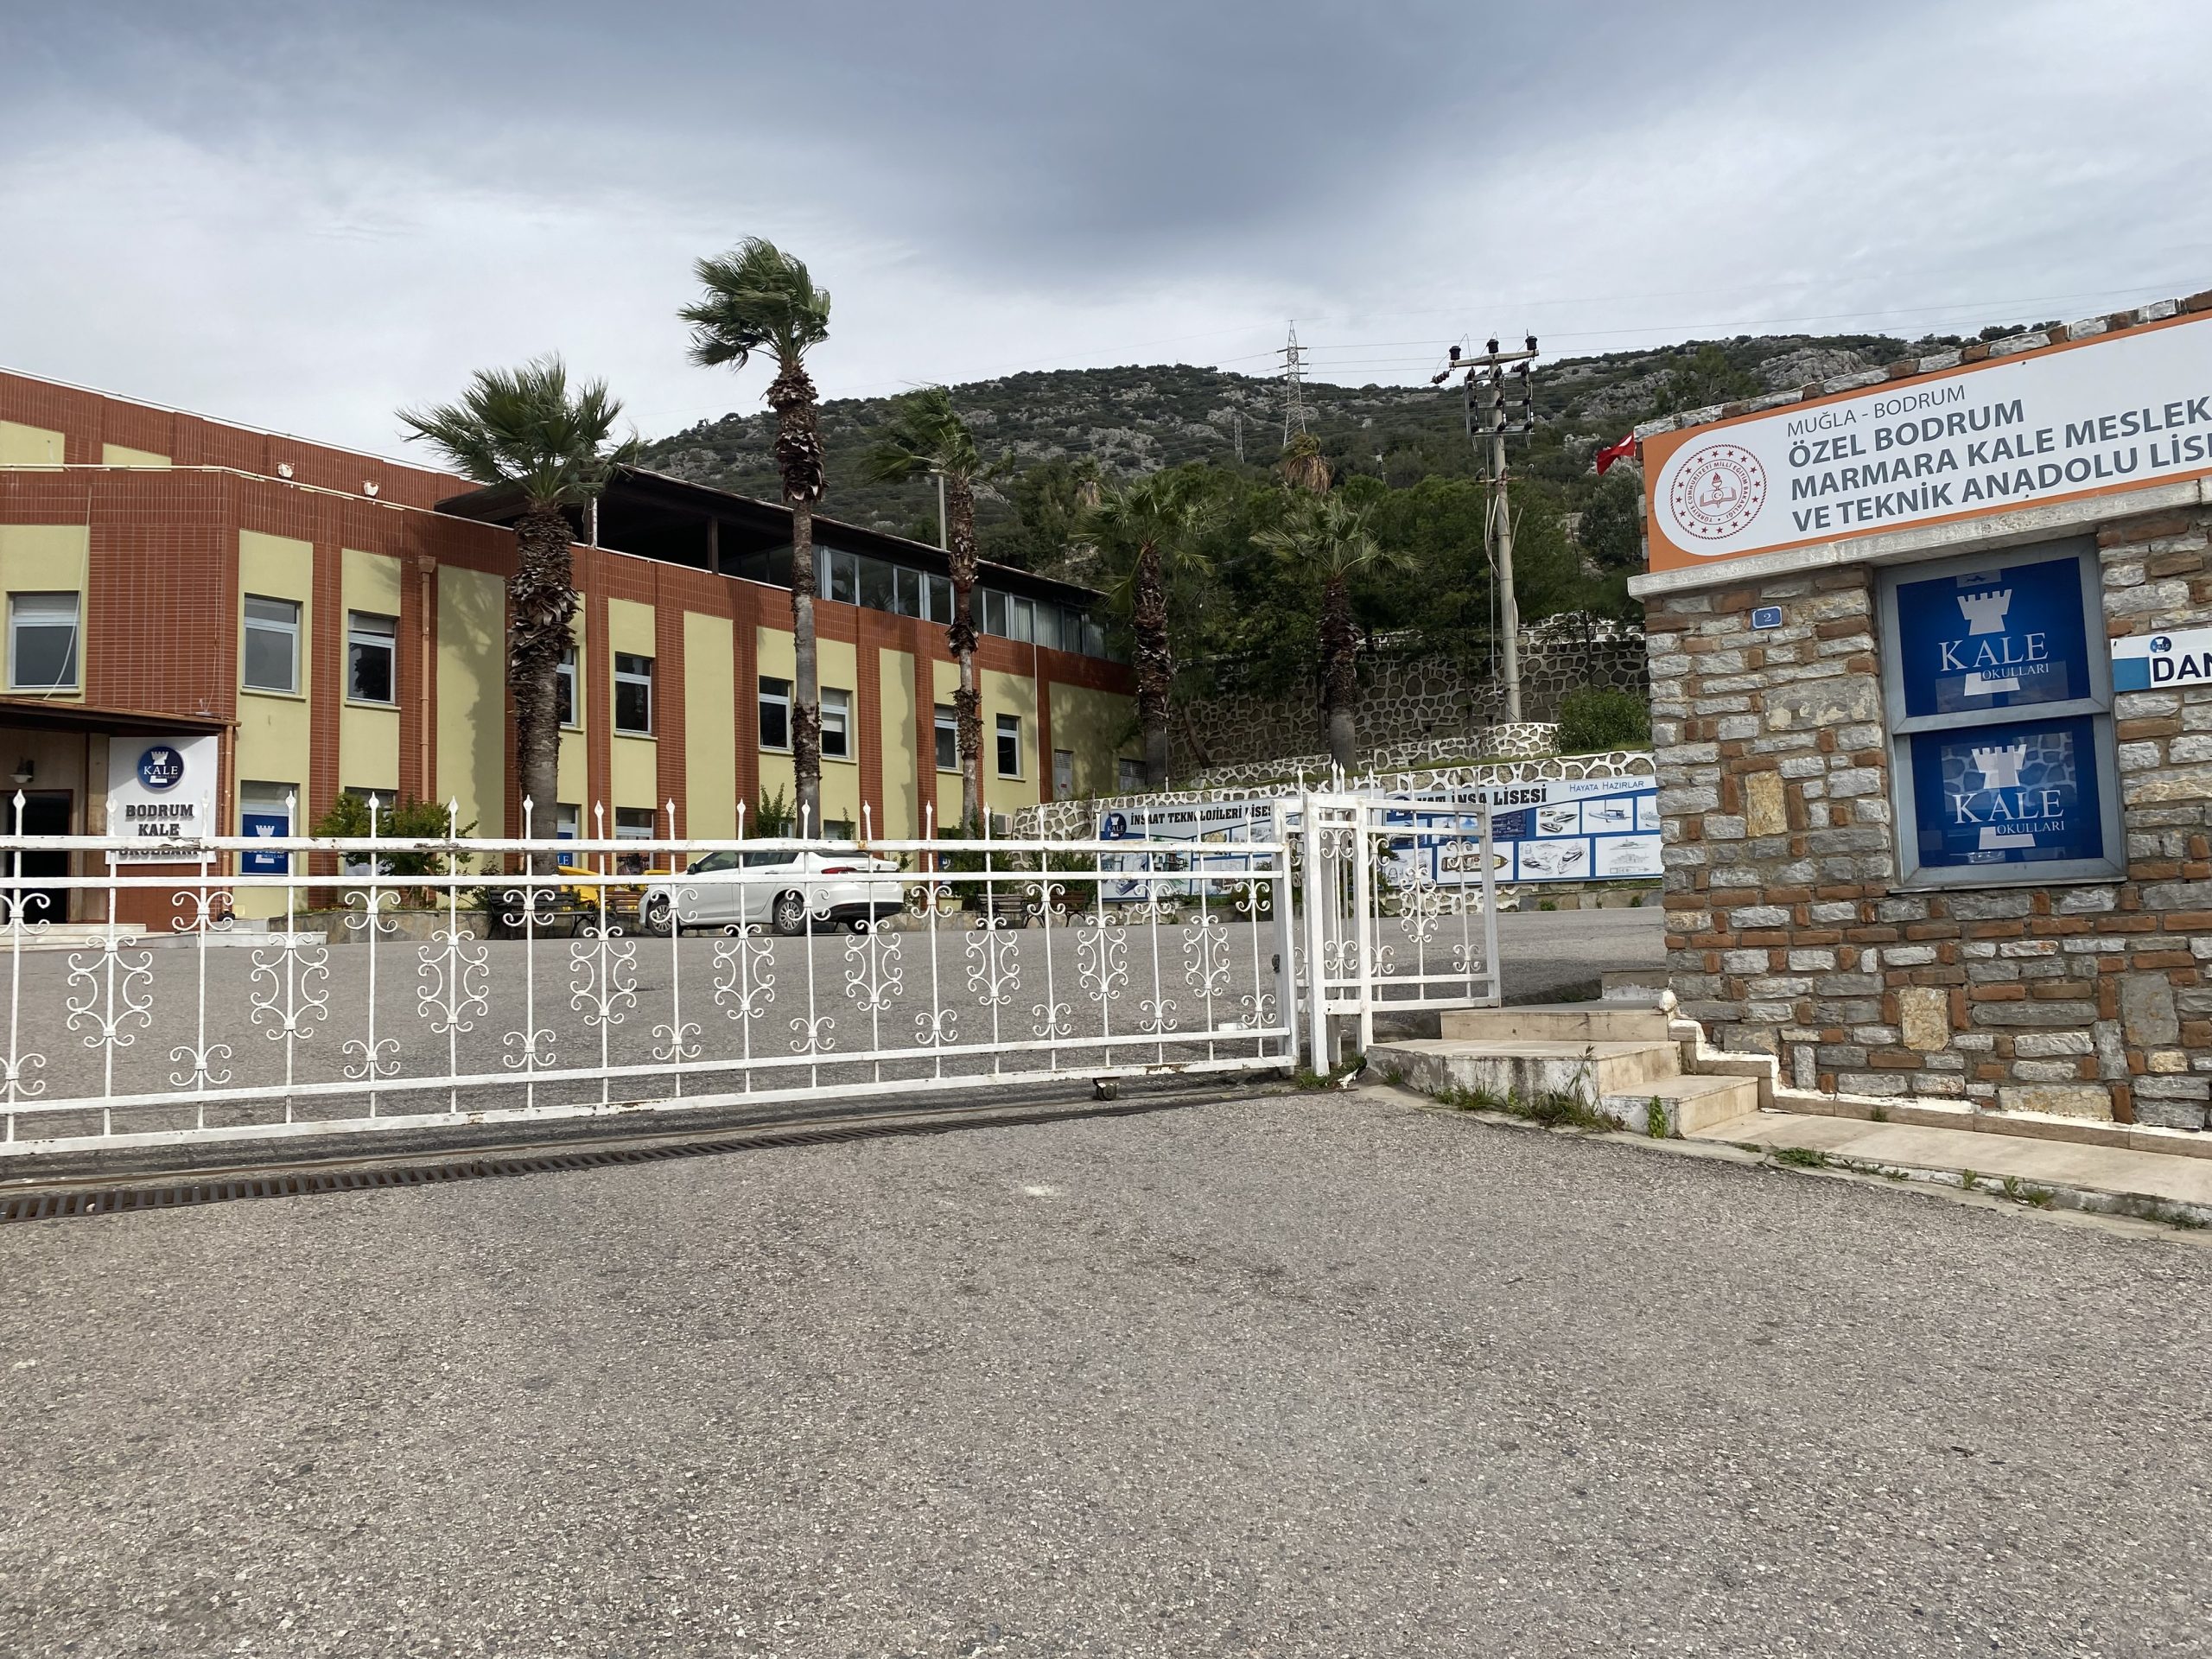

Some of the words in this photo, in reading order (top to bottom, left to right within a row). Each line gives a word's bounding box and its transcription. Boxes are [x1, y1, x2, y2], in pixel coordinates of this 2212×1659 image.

[1787, 409, 1857, 437] MUĞLA
[1873, 385, 1966, 419] BODRUM
[1789, 434, 1867, 467] ÖZEL
[1874, 398, 2024, 452] BODRUM
[1791, 448, 1959, 500] MARMARA
[1967, 427, 2056, 467] KALE
[1792, 505, 1831, 532] VE
[1836, 481, 1954, 524] TEKNİK
[1961, 447, 2139, 503] ANADOLU
[2150, 433, 2212, 468] LİS
[1763, 613, 1772, 623] 2
[1937, 632, 2049, 672] KALE
[1982, 663, 2050, 681] OKULLARI
[143, 766, 178, 775] KALE
[1493, 784, 1547, 806] LİSESİ
[1569, 783, 1599, 792] HAYATA
[1602, 780, 1644, 791] HAZIRLAR
[125, 804, 194, 817] BODRUM
[1167, 804, 1243, 823] TEKNLOJİLERİ
[1952, 789, 2064, 824] KALE
[137, 823, 180, 836] KALE
[1997, 820, 2065, 835] OKULLARI
